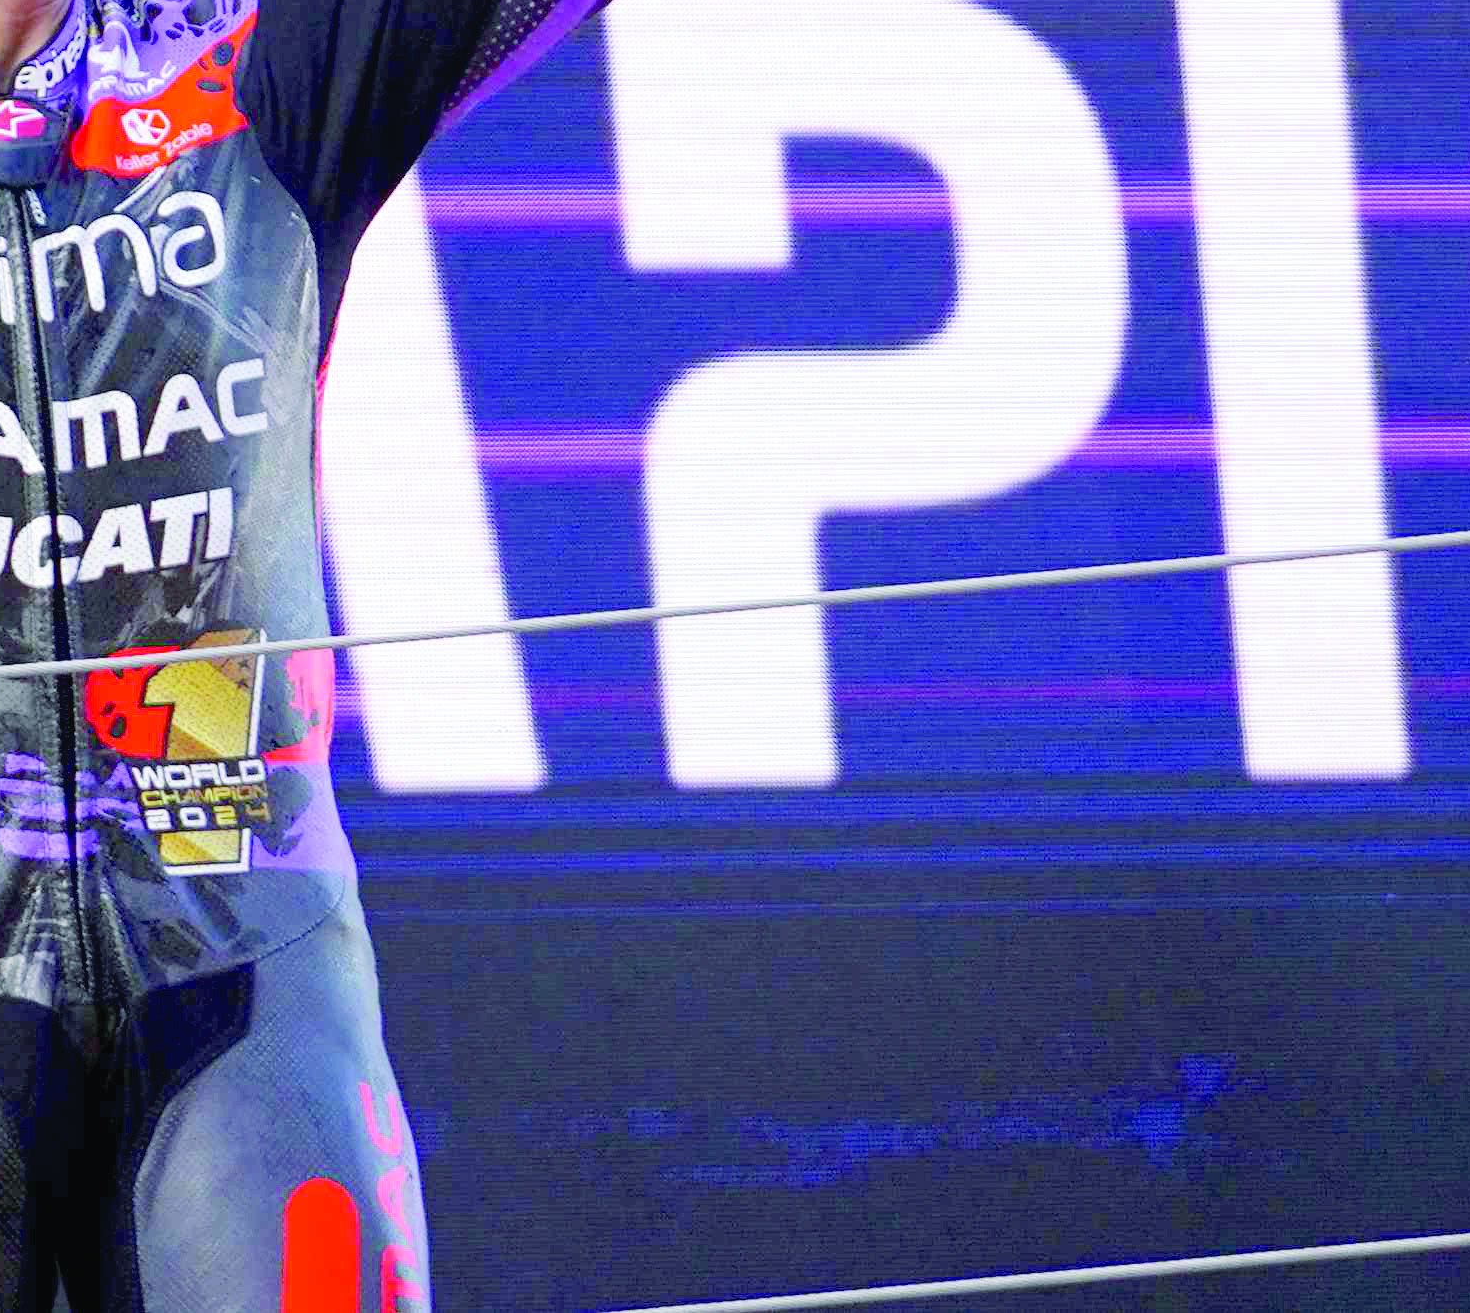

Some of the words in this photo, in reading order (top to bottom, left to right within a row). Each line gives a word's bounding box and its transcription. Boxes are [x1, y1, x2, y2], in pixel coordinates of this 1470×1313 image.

[131, 759, 266, 790] WORLD
[140, 784, 269, 808] CHAMPION
[143, 801, 271, 831] 2024
